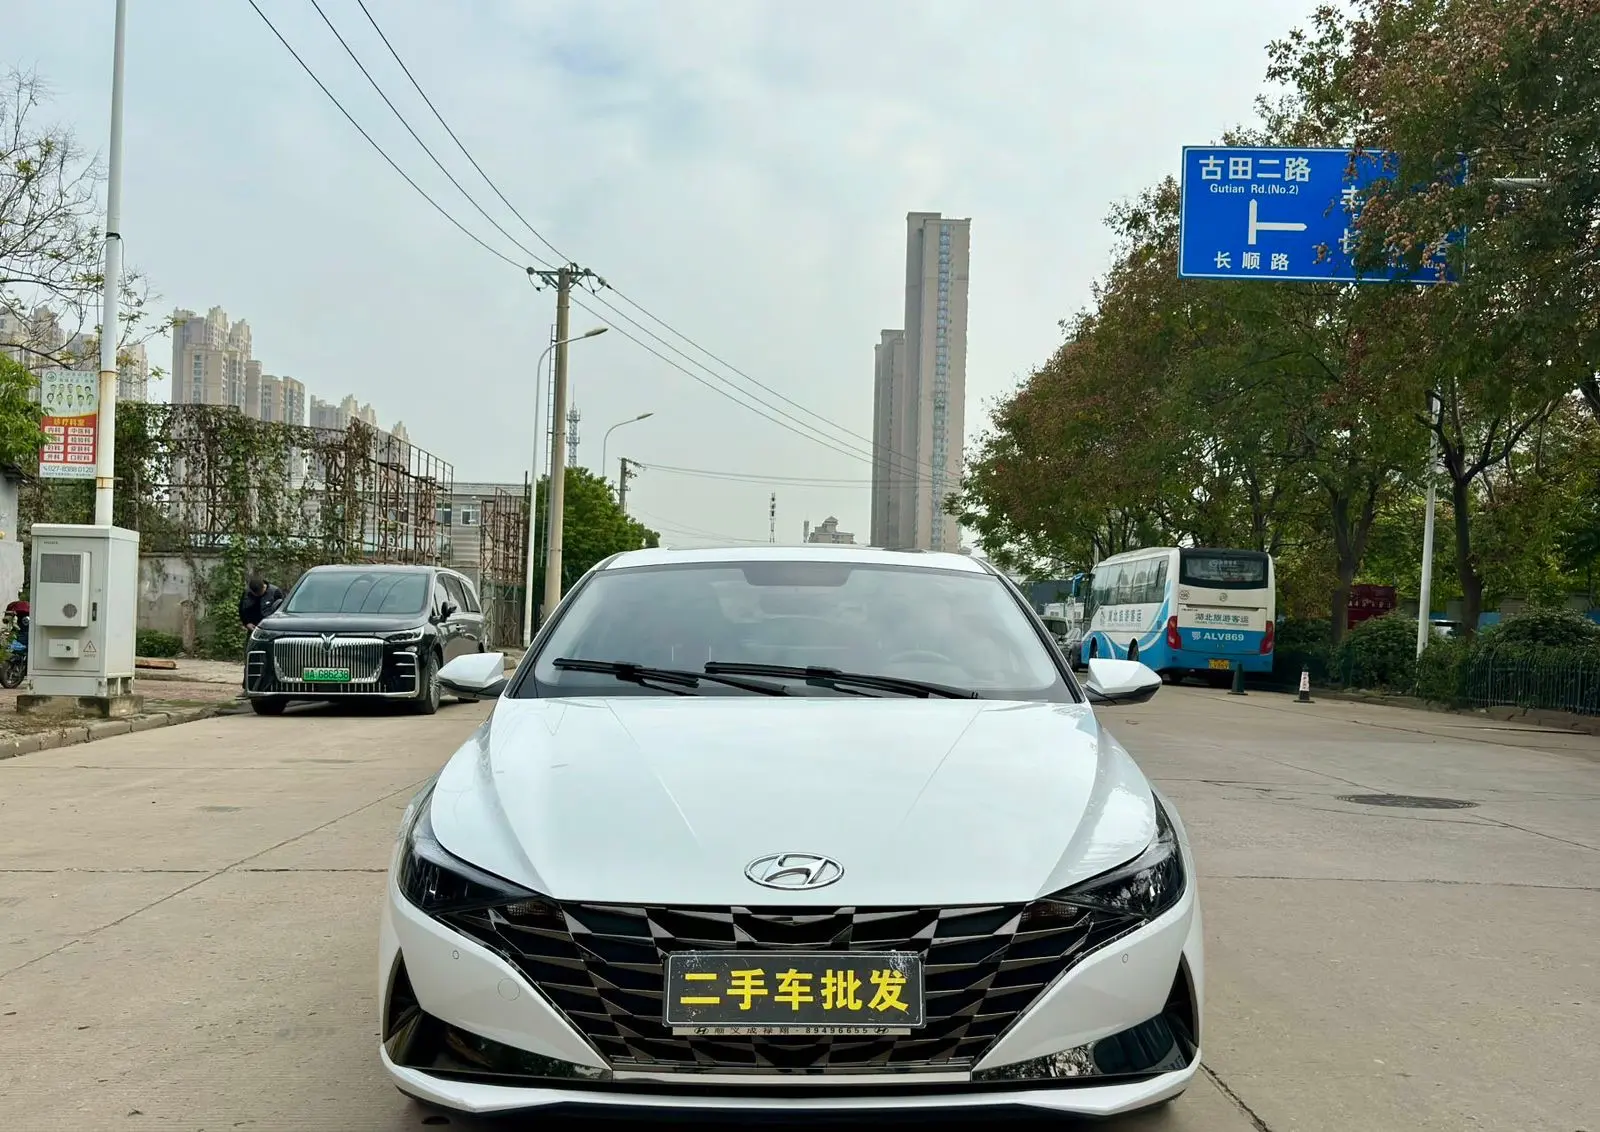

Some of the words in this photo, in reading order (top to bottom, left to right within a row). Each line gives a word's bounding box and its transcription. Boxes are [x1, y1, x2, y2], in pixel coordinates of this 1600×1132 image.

[1199, 155, 1311, 182] 古田二路
[1210, 183, 1245, 194] Gutian
[1251, 183, 1299, 195] Rd.(No.2)
[1214, 251, 1289, 271] 长顺路
[1195, 613, 1249, 623] 湖北旅游客运
[680, 968, 909, 1013] 二手车批发
